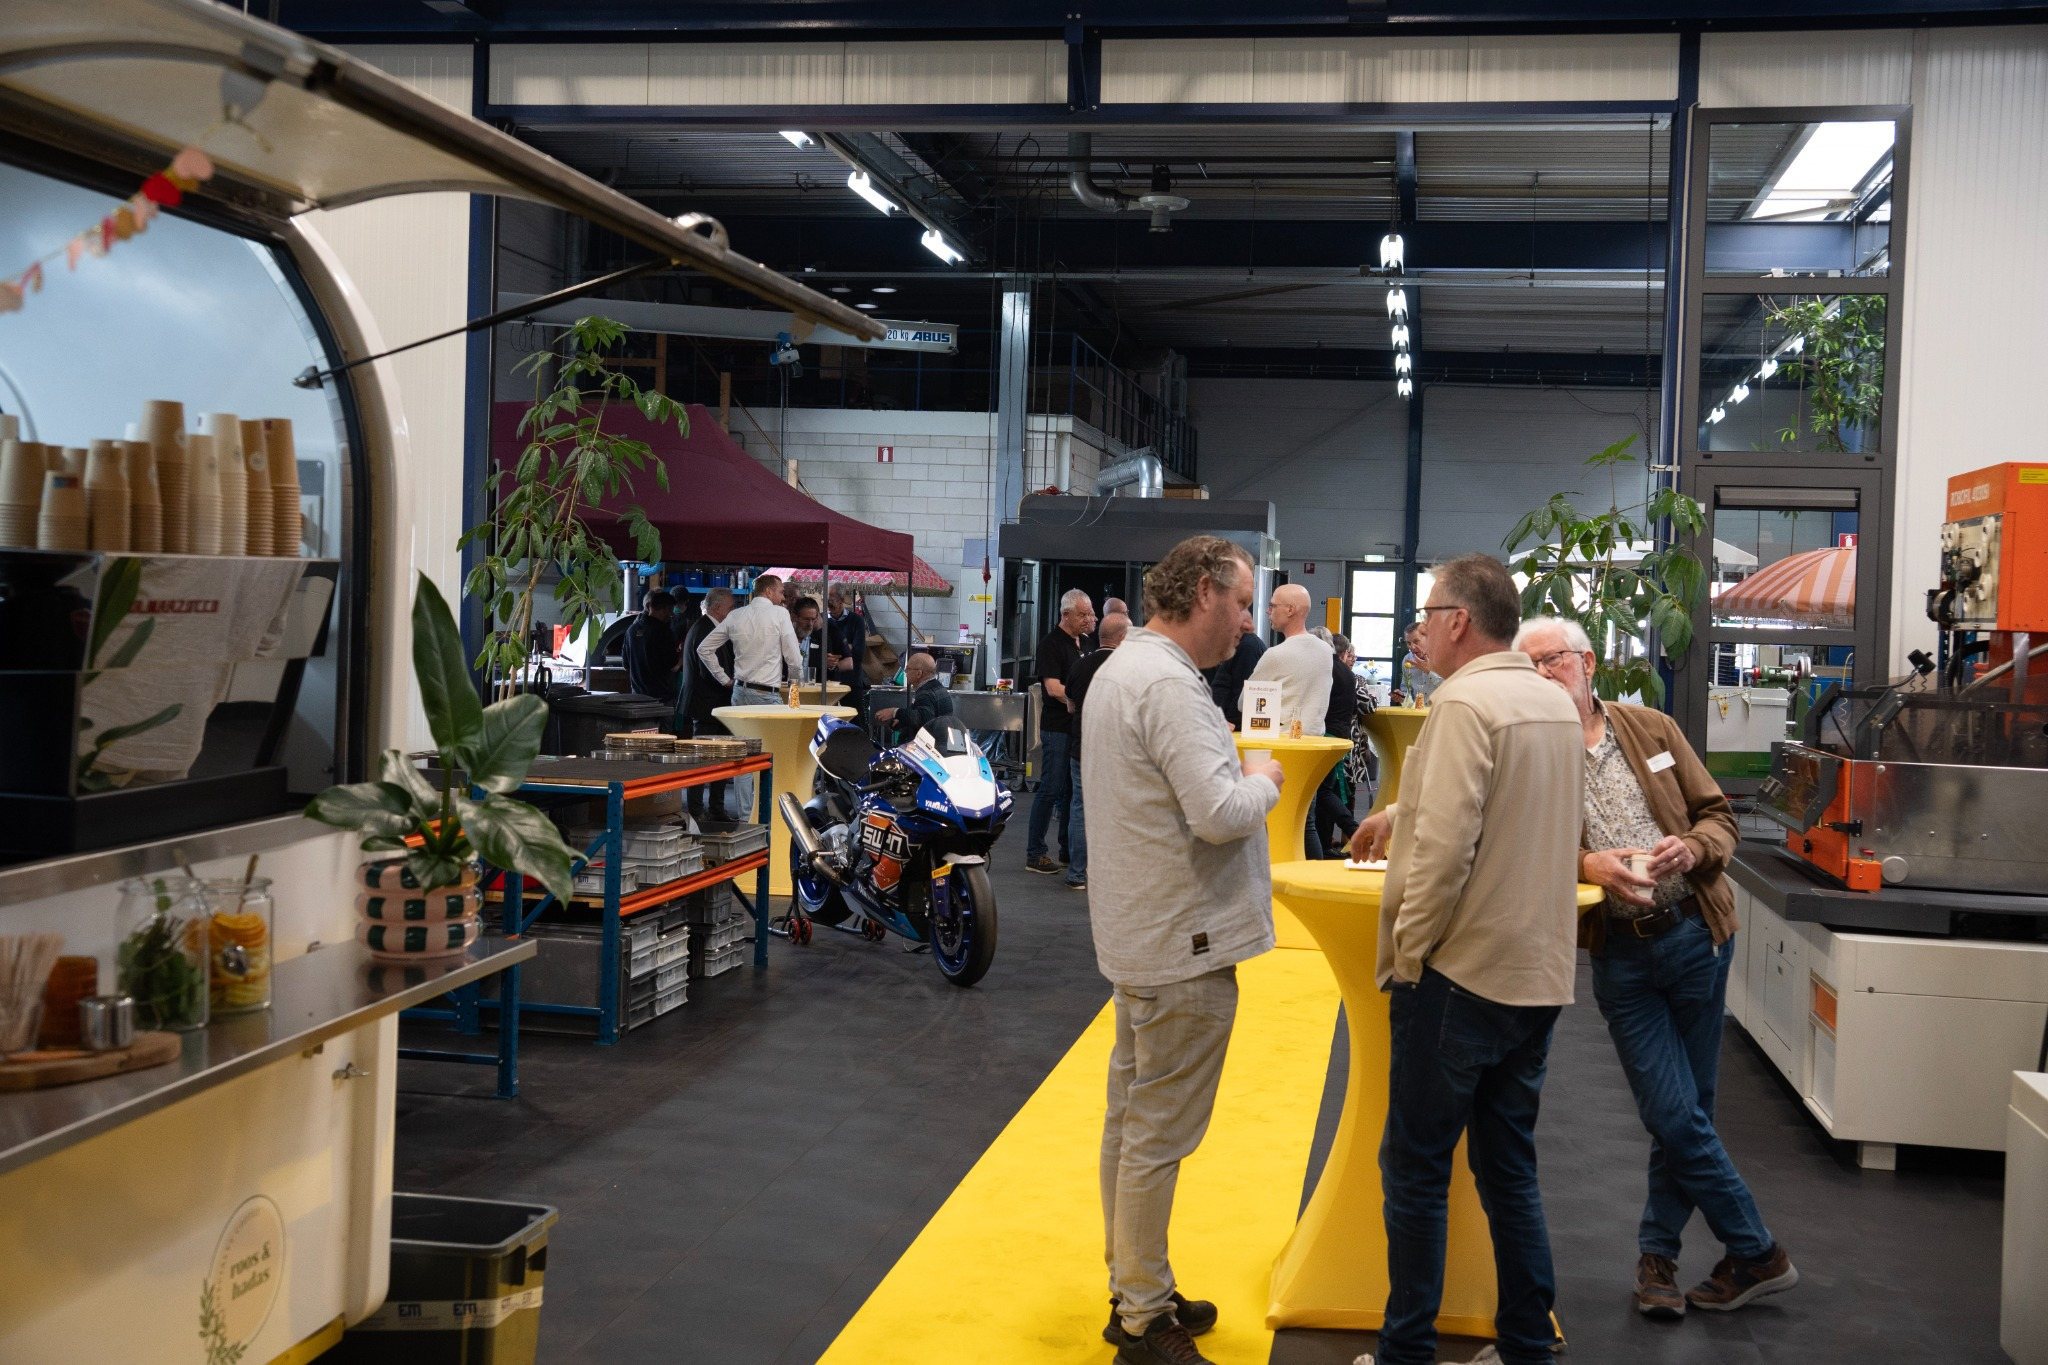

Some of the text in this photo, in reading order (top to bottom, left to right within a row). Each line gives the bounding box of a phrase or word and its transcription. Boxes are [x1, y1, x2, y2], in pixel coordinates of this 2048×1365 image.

[901, 329, 909, 341] kg
[912, 331, 950, 342] ABUS
[925, 799, 949, 814] YAMAHA
